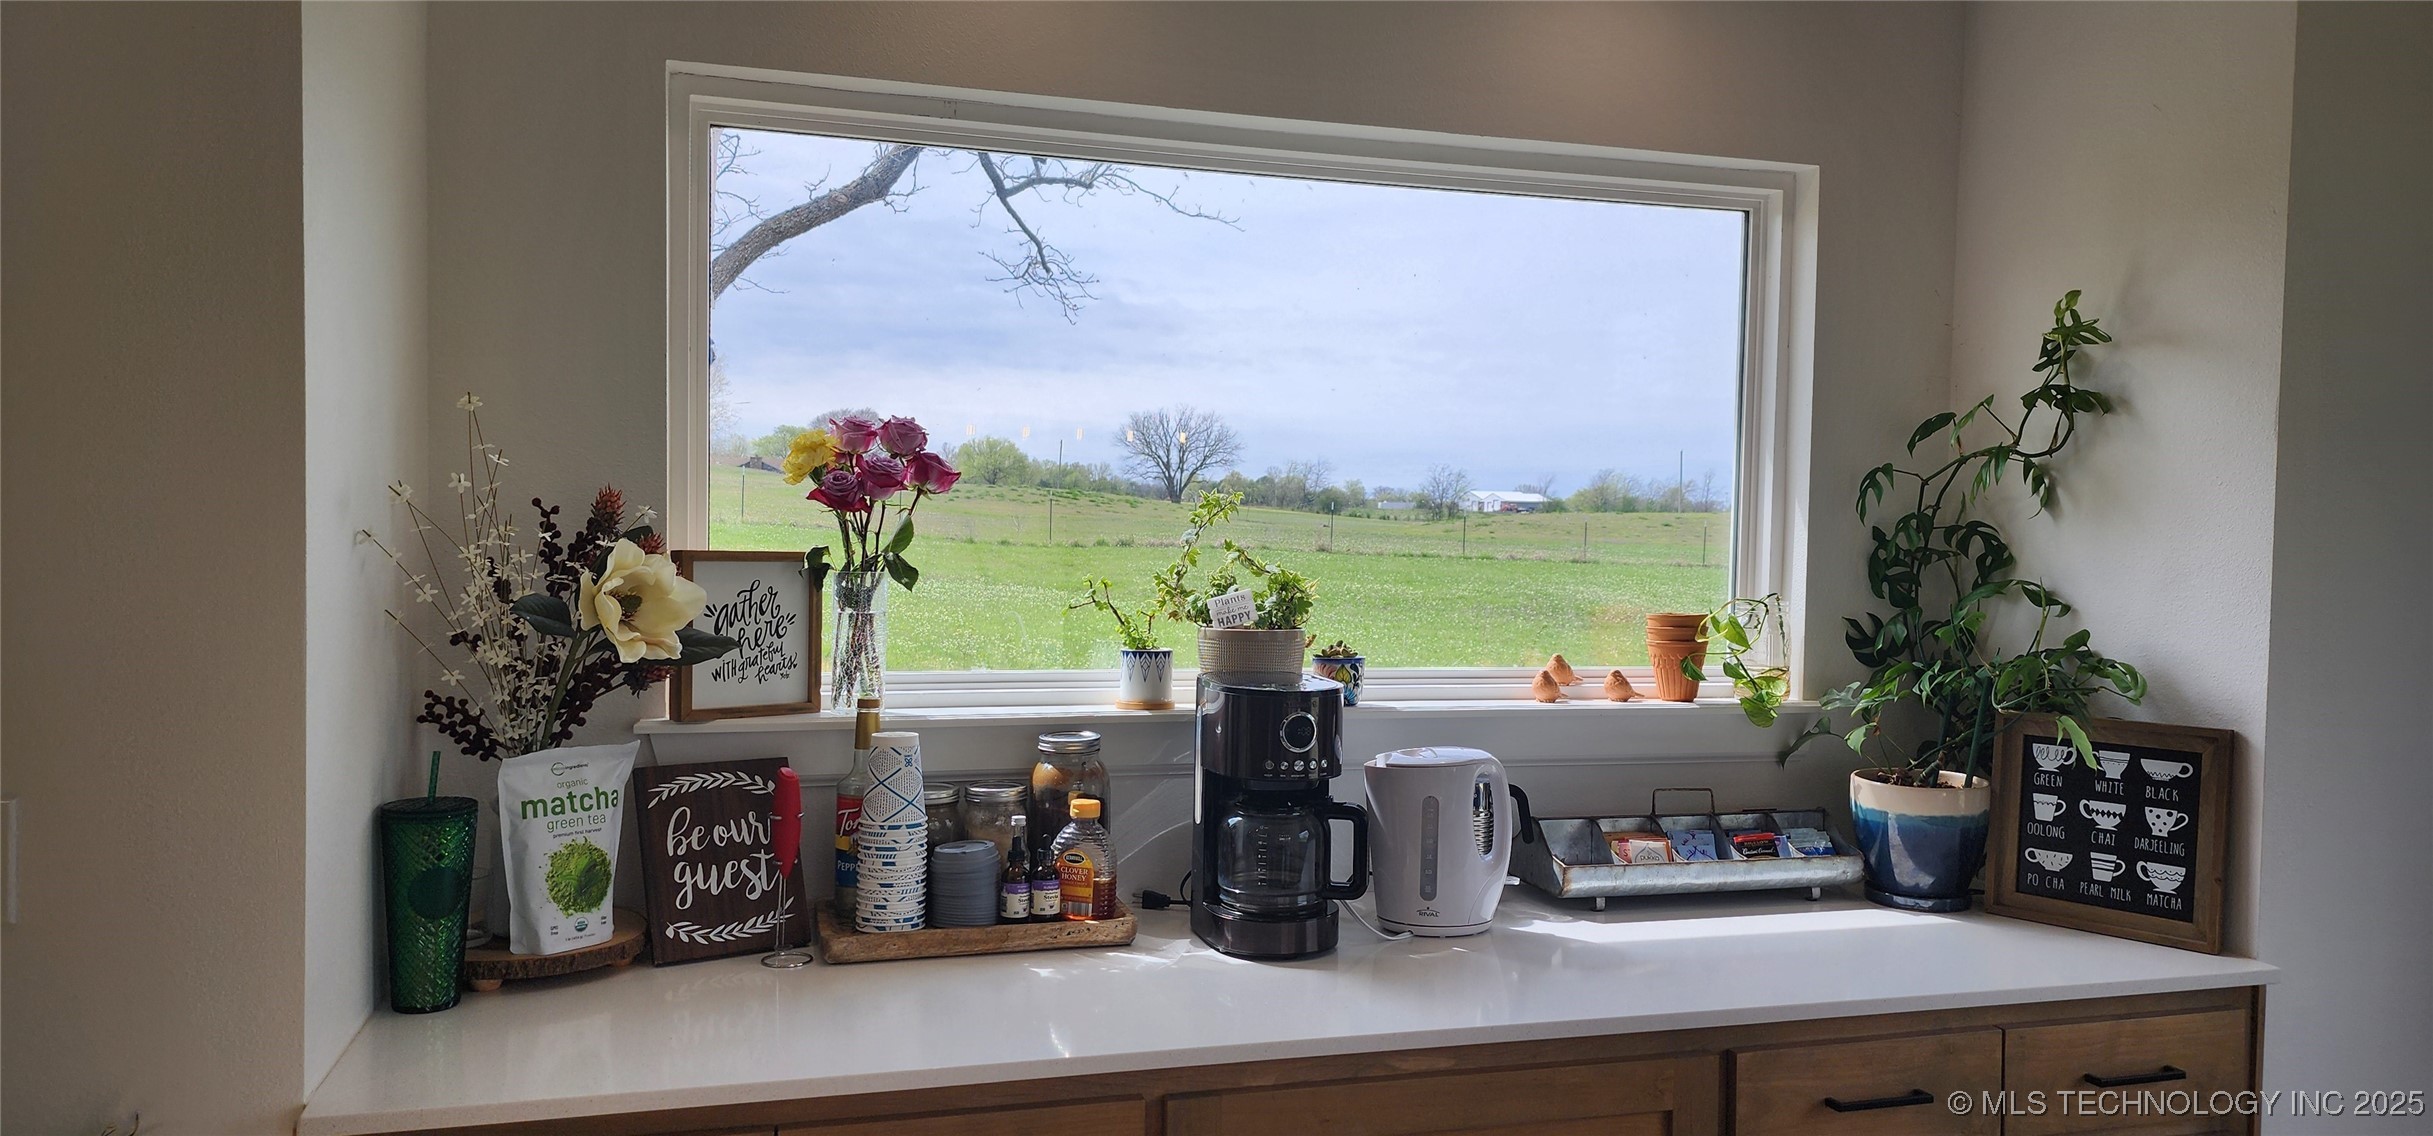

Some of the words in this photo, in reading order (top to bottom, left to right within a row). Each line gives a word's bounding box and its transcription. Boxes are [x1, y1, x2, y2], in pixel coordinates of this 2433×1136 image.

[714, 579, 781, 637] gather
[1214, 595, 1246, 607] Plants
[1216, 606, 1237, 616] make
[1217, 611, 1251, 627] HAPPY
[737, 615, 788, 659] here
[738, 641, 786, 684] grateful
[556, 778, 589, 789] organic
[2033, 772, 2063, 787] GREEN
[2094, 780, 2125, 796] WHITE
[2145, 786, 2179, 802] BLACK
[521, 786, 619, 820] matcha
[546, 817, 584, 833] green
[588, 814, 606, 825] tea
[667, 806, 711, 857] be
[713, 811, 771, 847] our
[2027, 822, 2065, 840] OOLONG
[2090, 831, 2116, 847] CHAI
[2134, 837, 2186, 857] DARJEELING
[1060, 866, 1088, 875] CLOVER
[1061, 873, 1087, 881] HONEY
[673, 849, 781, 910] guest
[2027, 873, 2039, 886] PO
[2046, 874, 2065, 890] CHA
[2080, 882, 2104, 898] PEARL
[2110, 888, 2132, 902] MILK
[2146, 893, 2183, 910] MATCHA
